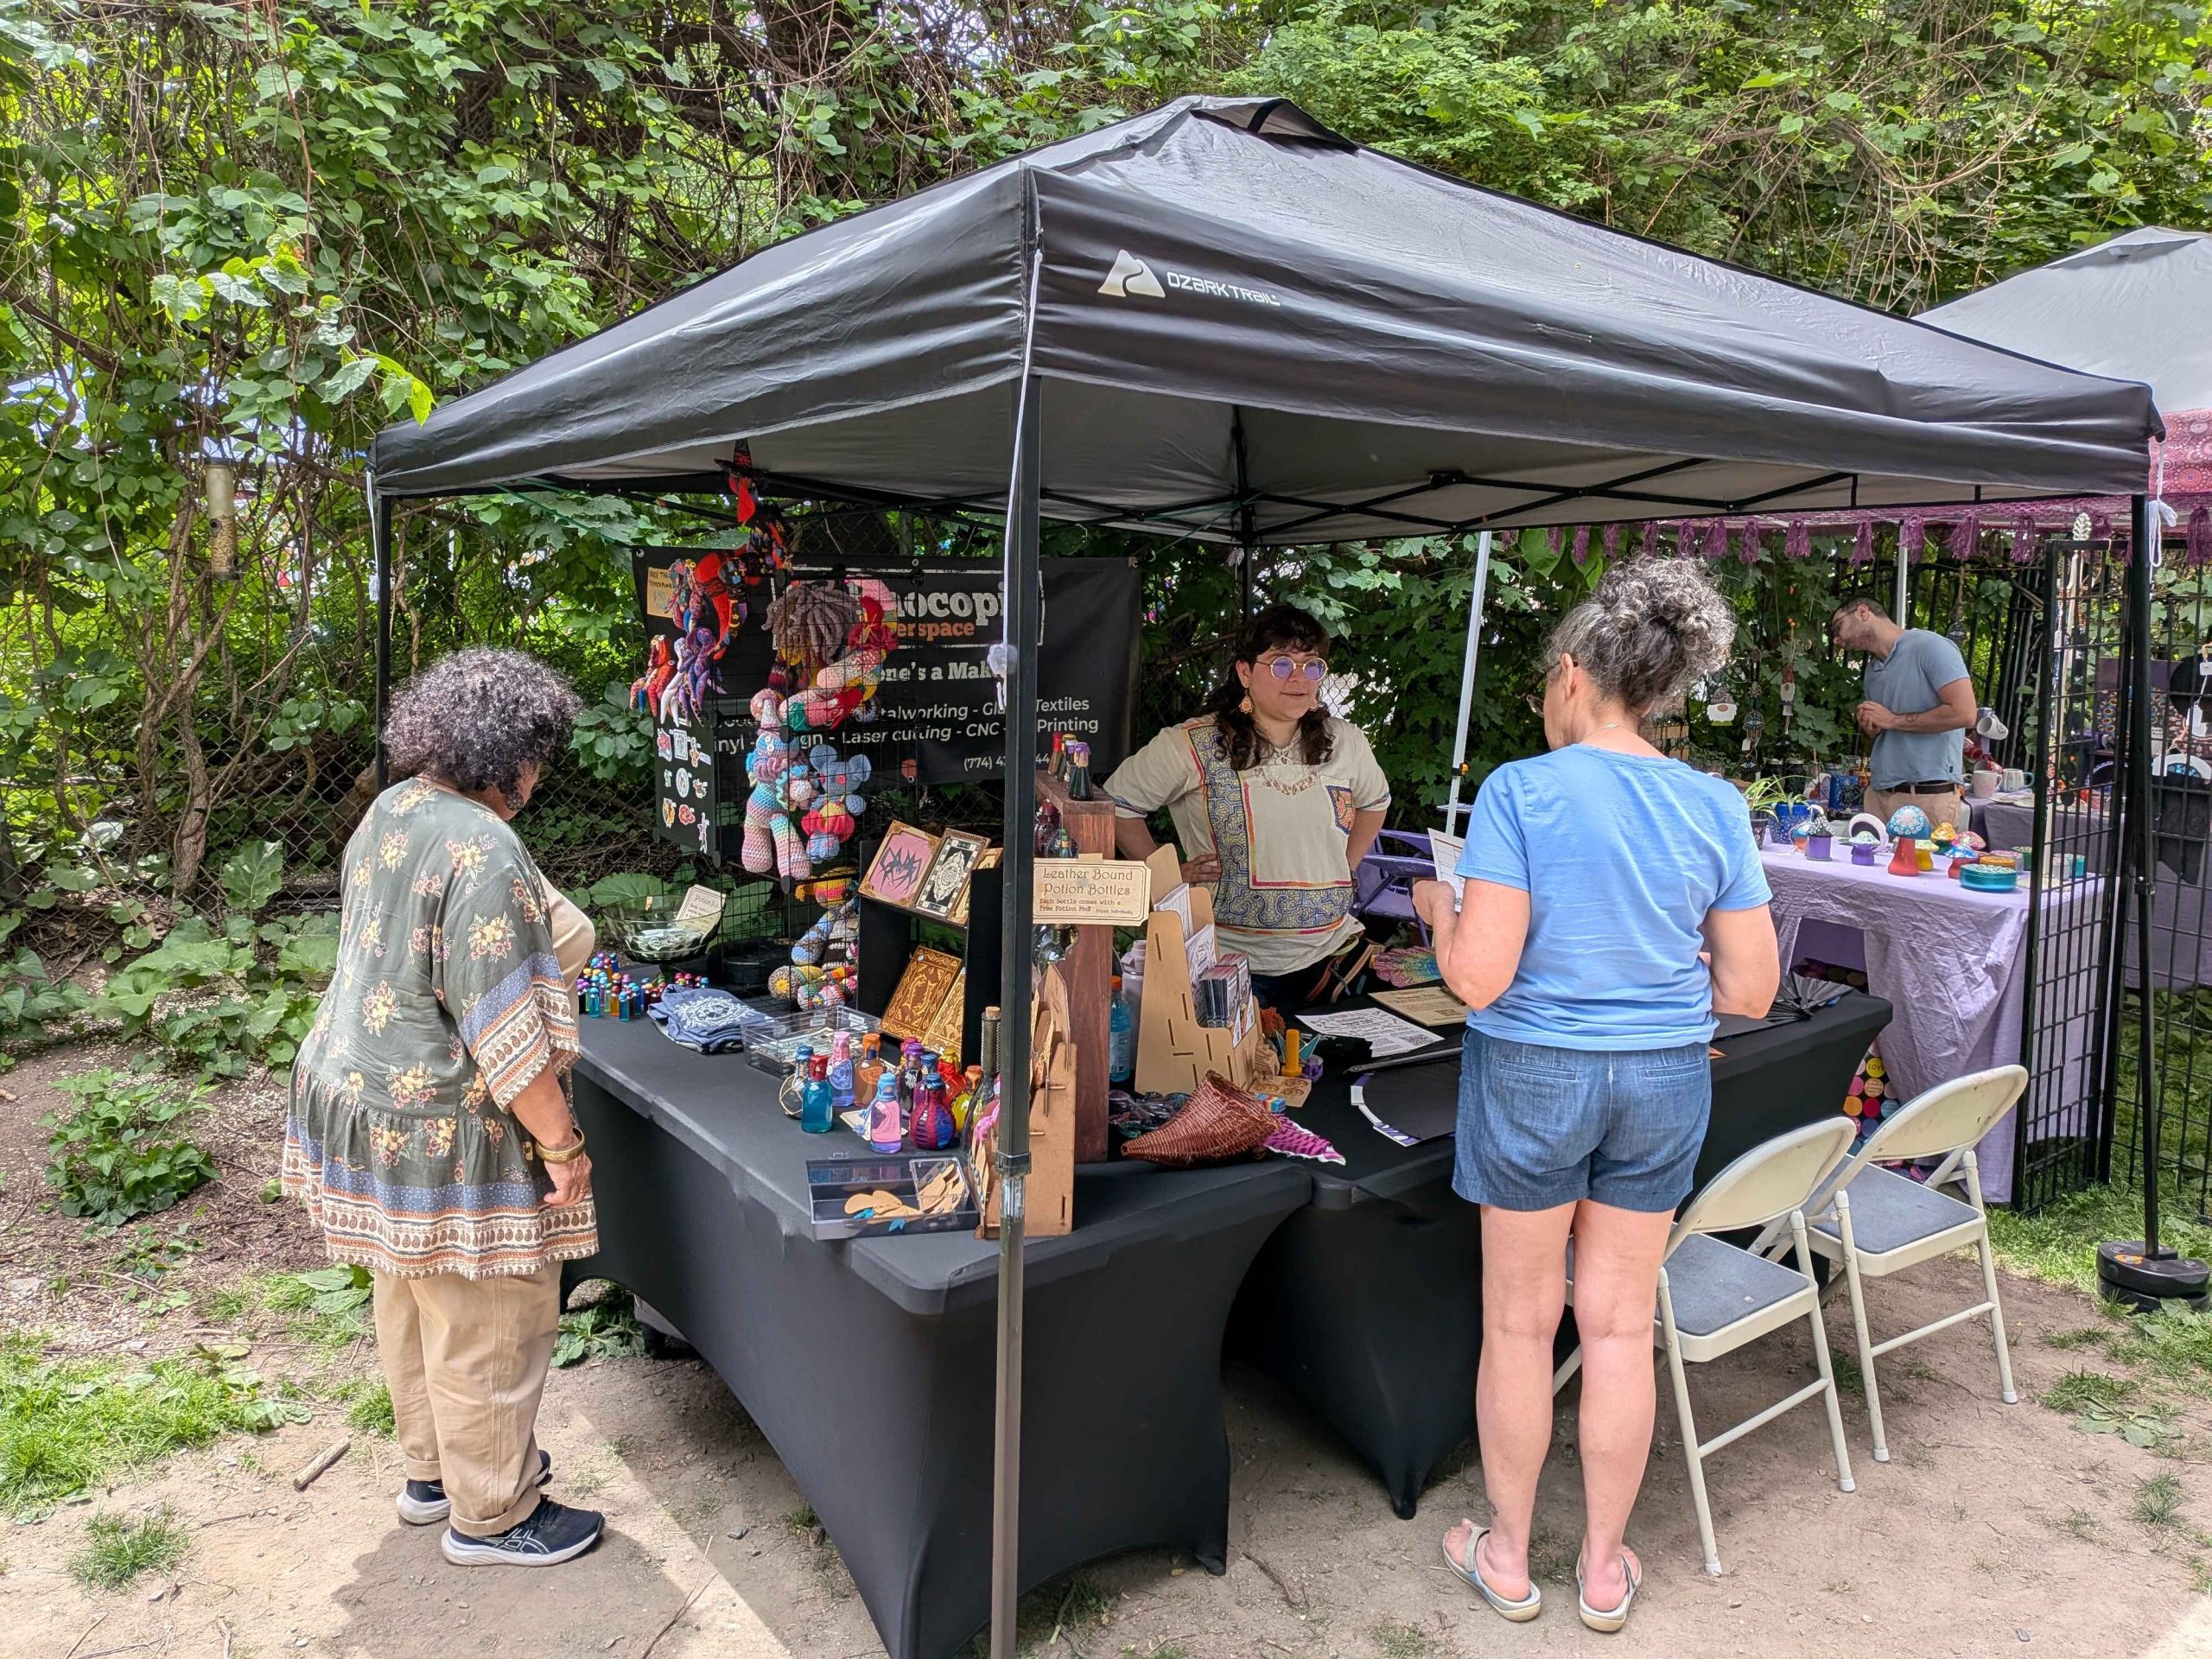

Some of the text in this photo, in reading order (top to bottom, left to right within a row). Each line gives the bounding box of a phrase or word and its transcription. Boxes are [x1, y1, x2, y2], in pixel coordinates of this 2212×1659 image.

[897, 621, 975, 641] erspace
[931, 666, 944, 681] a
[948, 662, 1000, 680] Mak
[880, 703, 968, 721] talworking
[1037, 697, 1090, 712] Textiles
[714, 734, 745, 755] inyl
[842, 731, 888, 744] Laser
[966, 722, 1000, 737] CNC
[1038, 716, 1099, 733] Printing
[964, 756, 993, 772] (774)
[1043, 868, 1133, 880] Leather Bound
[1043, 883, 1131, 896] Potion Bottles
